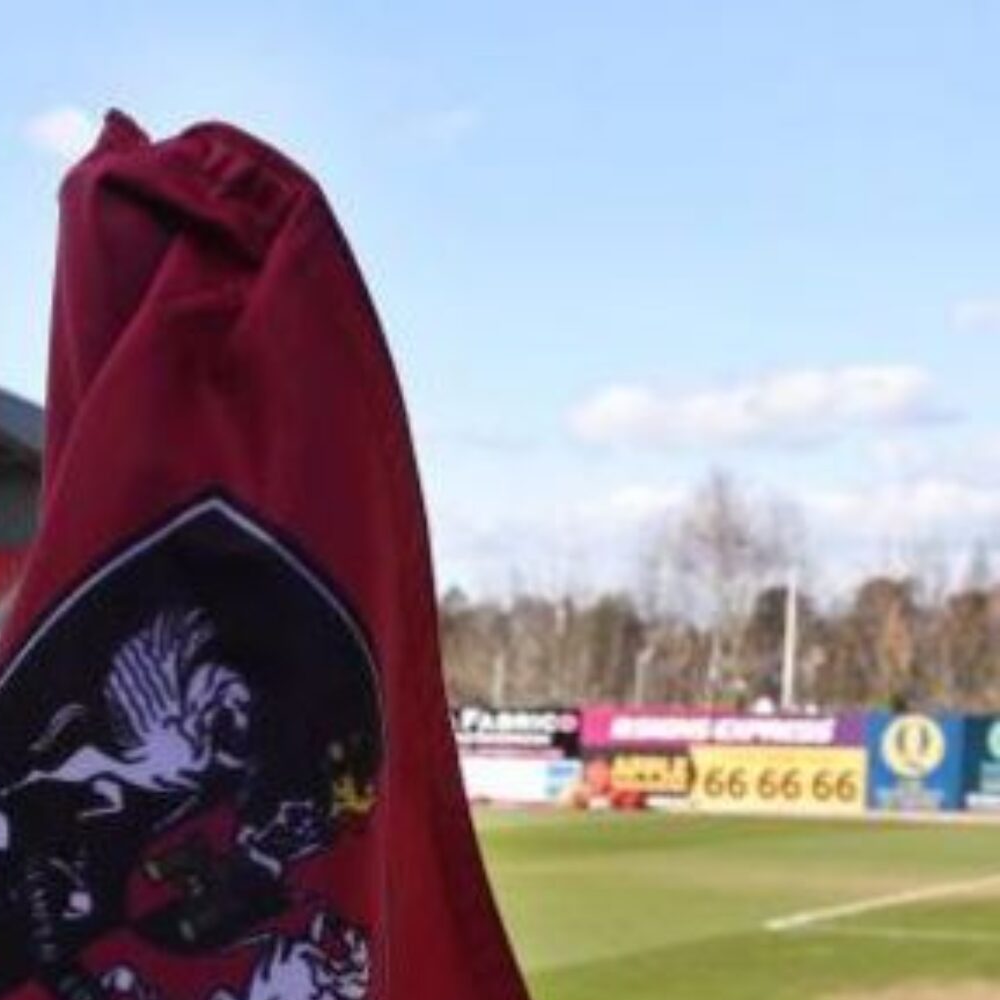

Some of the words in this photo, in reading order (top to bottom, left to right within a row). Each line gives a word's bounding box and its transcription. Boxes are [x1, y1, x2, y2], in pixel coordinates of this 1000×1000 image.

[704, 769, 747, 801] 66
[757, 770, 800, 802] 66
[812, 771, 855, 803] 66
